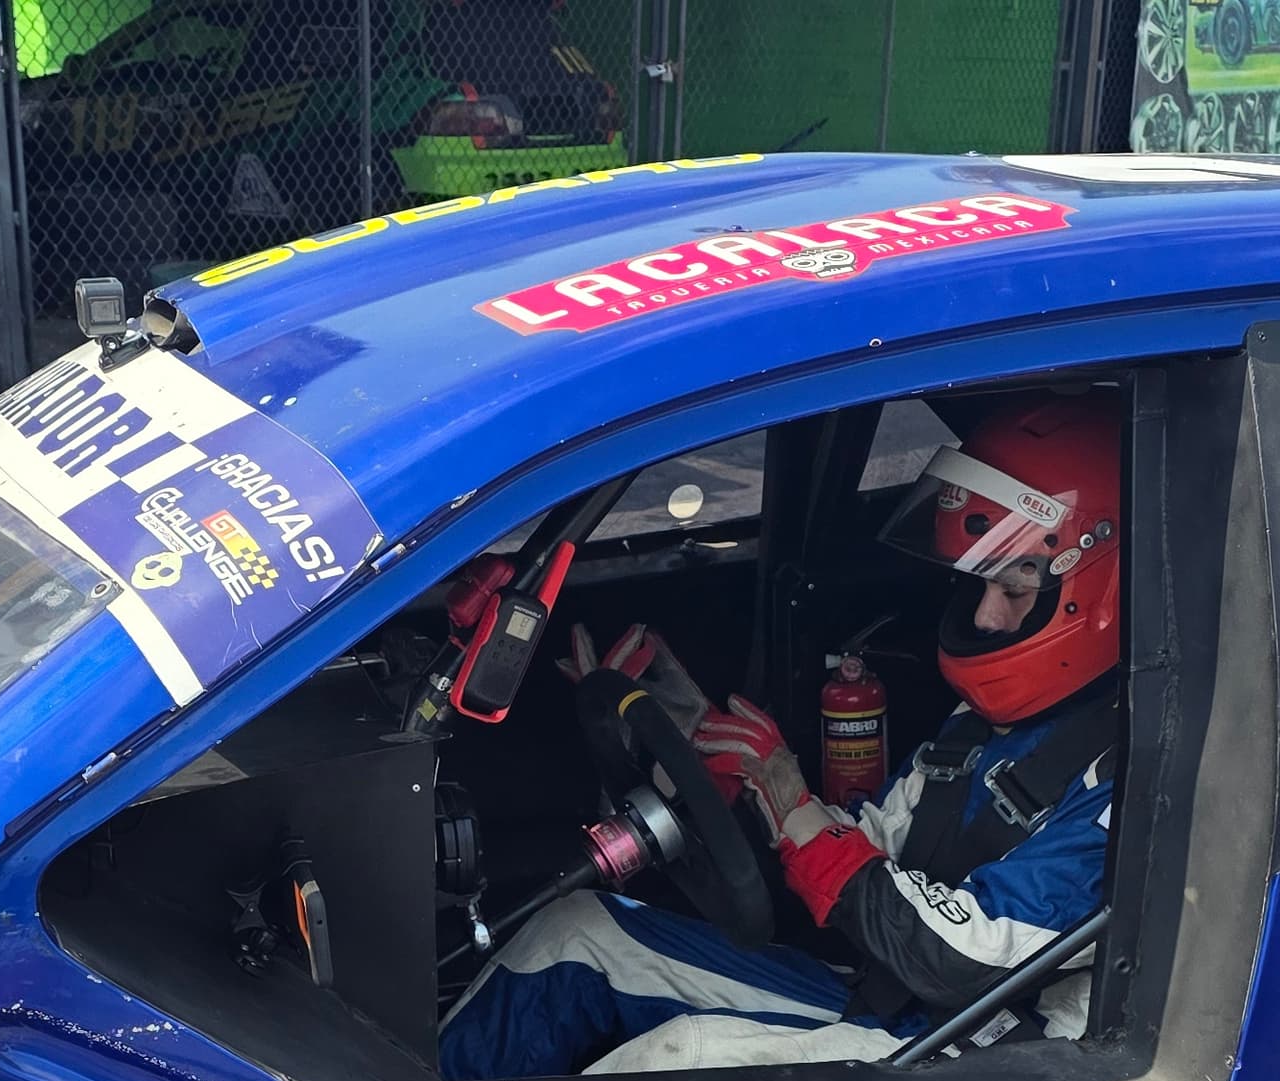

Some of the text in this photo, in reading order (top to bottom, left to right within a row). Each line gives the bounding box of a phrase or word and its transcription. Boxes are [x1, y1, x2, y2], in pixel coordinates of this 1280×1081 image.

[491, 196, 1052, 326] LACALACA
[607, 220, 1034, 315] TAQUERIA MEXICANA
[141, 487, 254, 606] CHALLENGE
[194, 454, 345, 583] ¡GRACIAS!
[1022, 494, 1053, 518] BELL
